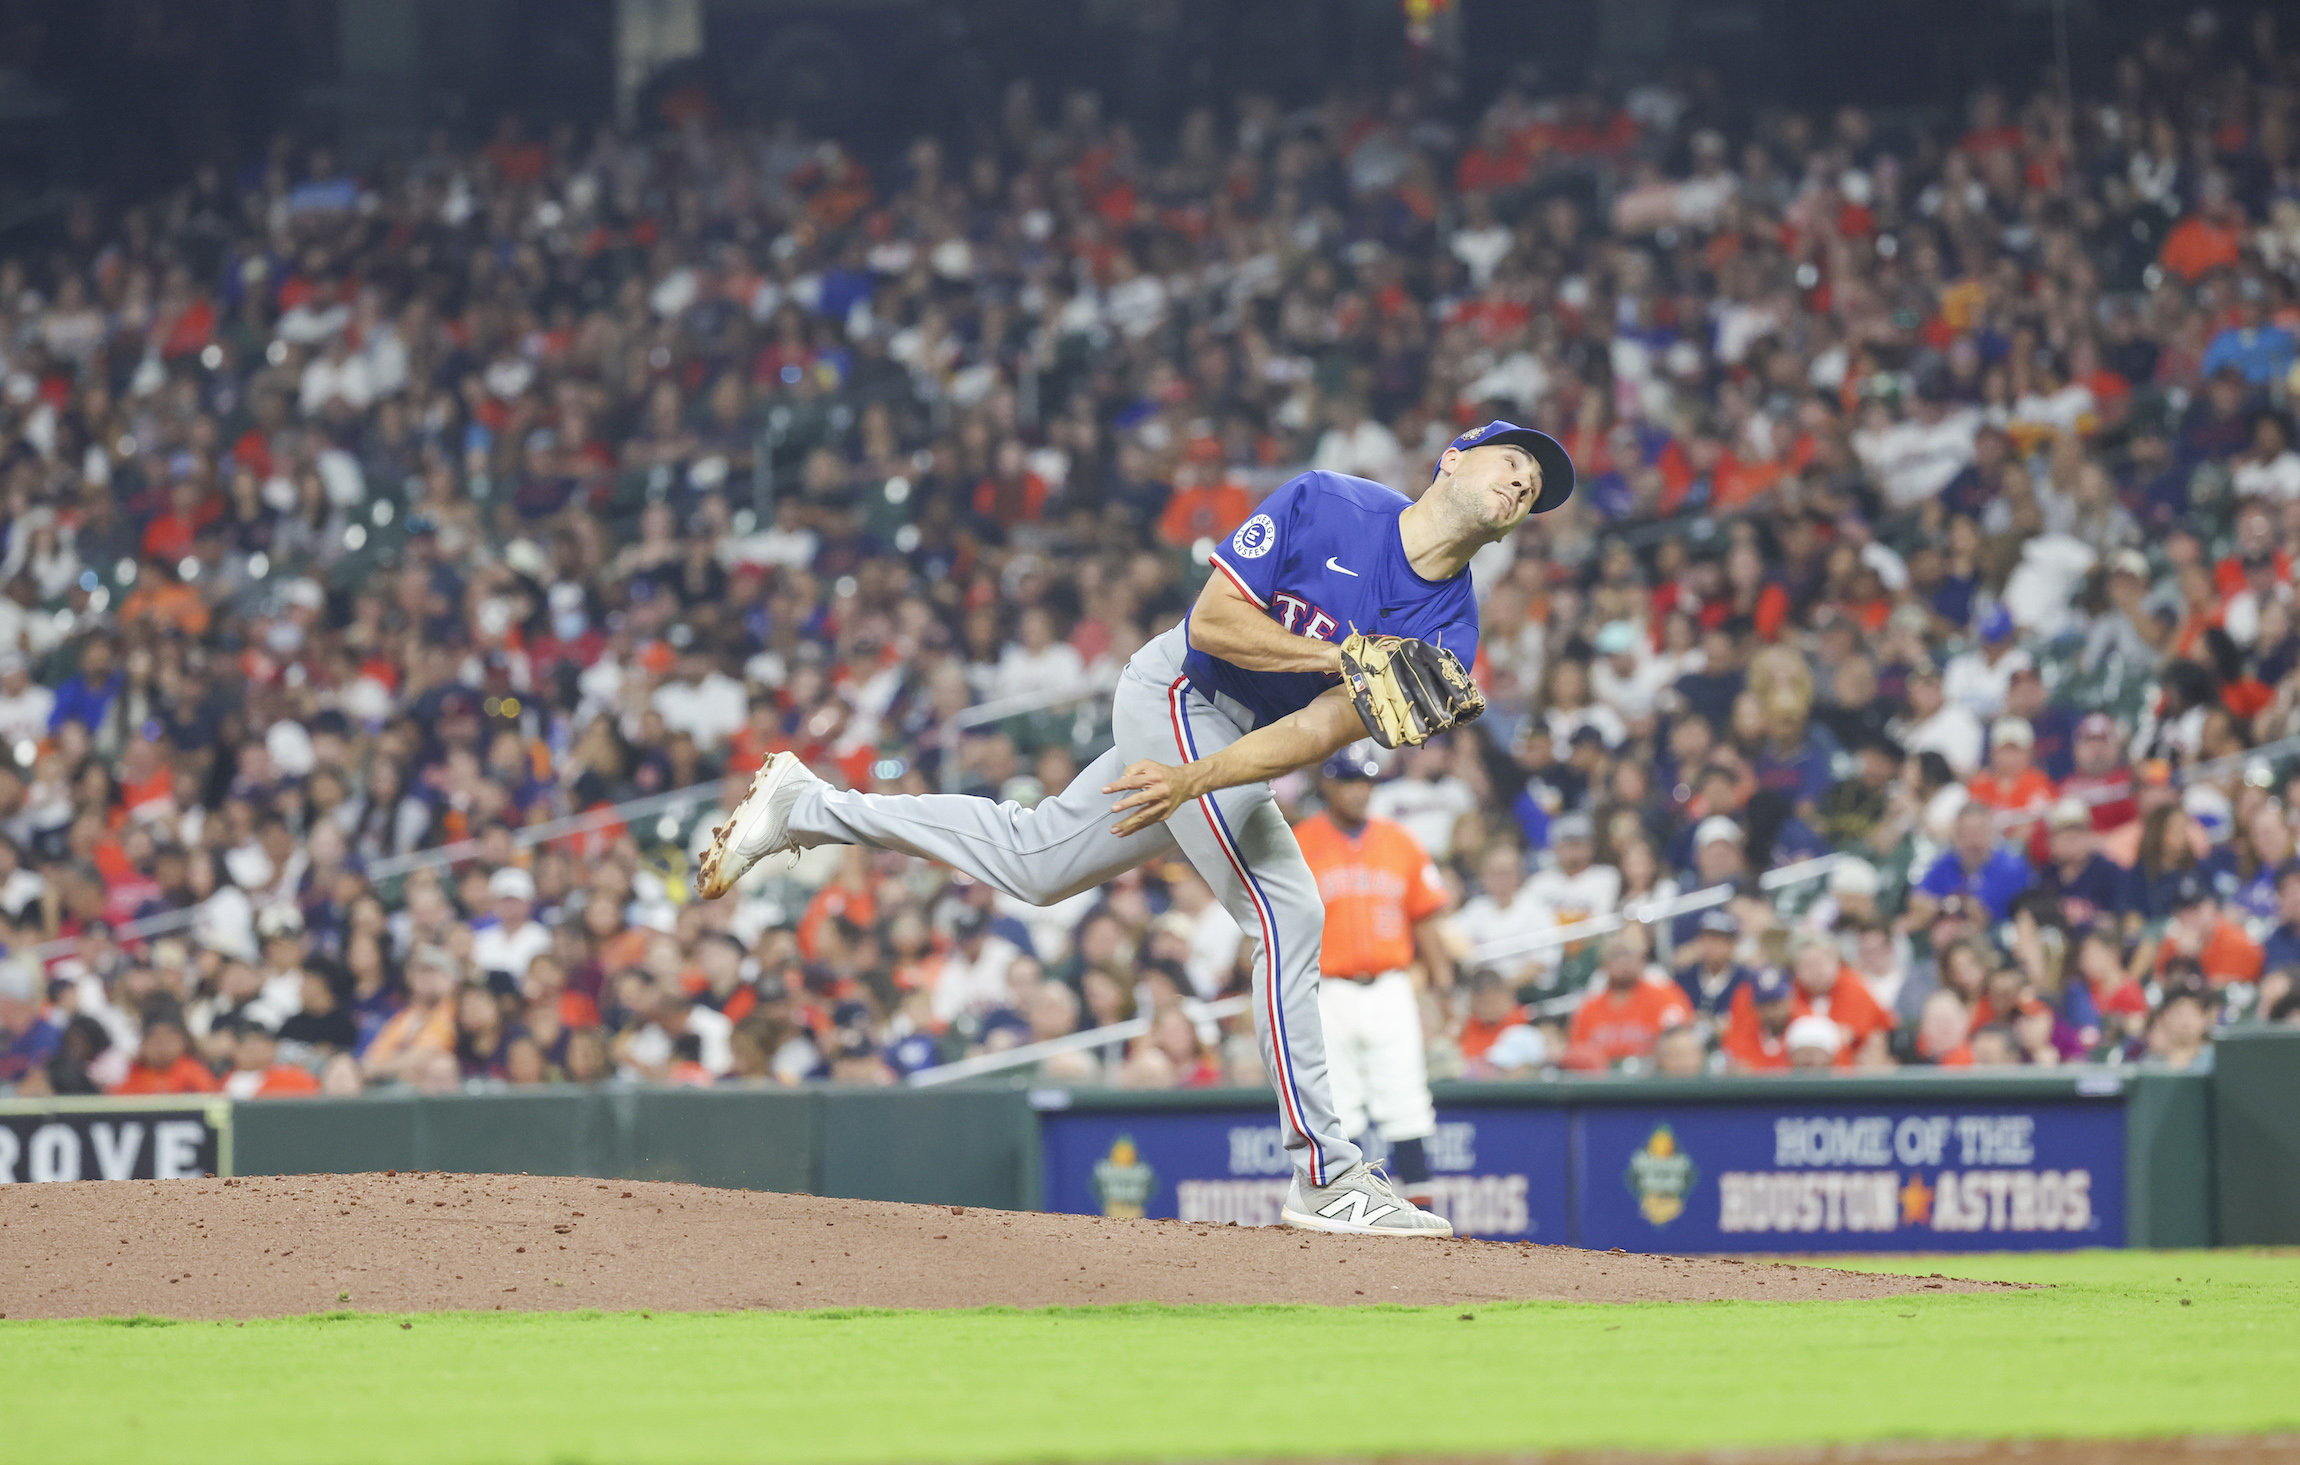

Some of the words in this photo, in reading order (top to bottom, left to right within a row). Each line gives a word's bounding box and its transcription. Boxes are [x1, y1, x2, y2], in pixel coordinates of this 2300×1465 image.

[1250, 515, 1274, 542] ENERGY
[1234, 529, 1267, 557] TRANSFER
[1931, 1169, 2092, 1232] ASTROS
